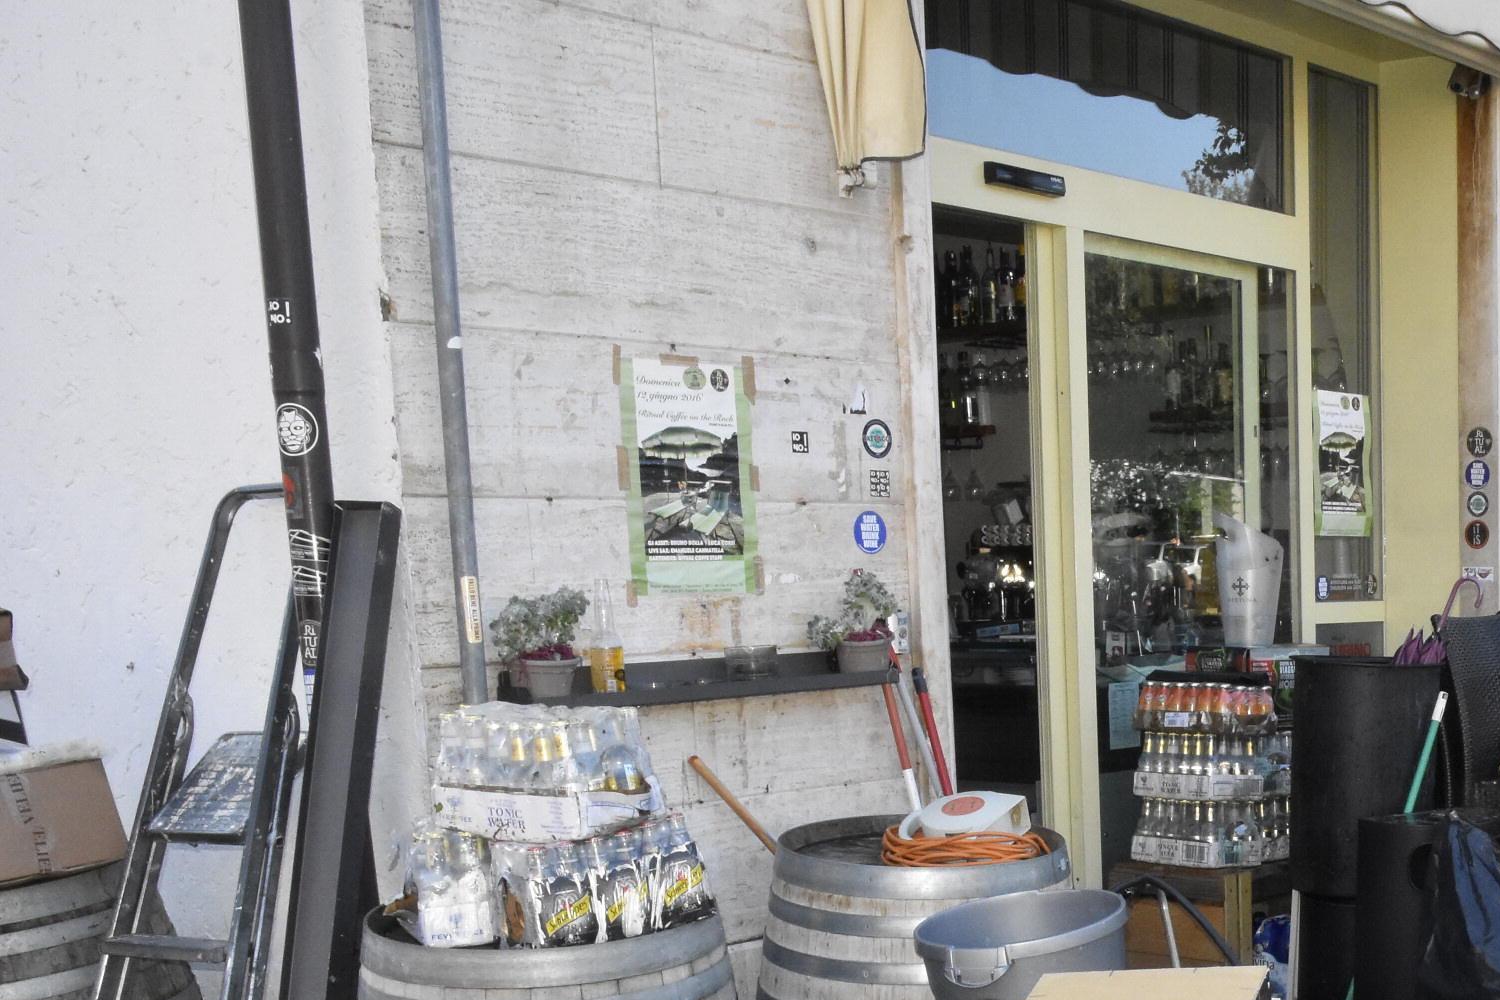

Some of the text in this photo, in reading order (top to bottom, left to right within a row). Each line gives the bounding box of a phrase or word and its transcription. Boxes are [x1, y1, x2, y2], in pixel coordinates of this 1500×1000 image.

[636, 375, 681, 387] Domenica
[862, 514, 877, 522] SAVE
[860, 523, 880, 531] WATER
[5, 772, 35, 825] VELIE
[487, 807, 523, 819] TONIC
[487, 817, 526, 830] WATER
